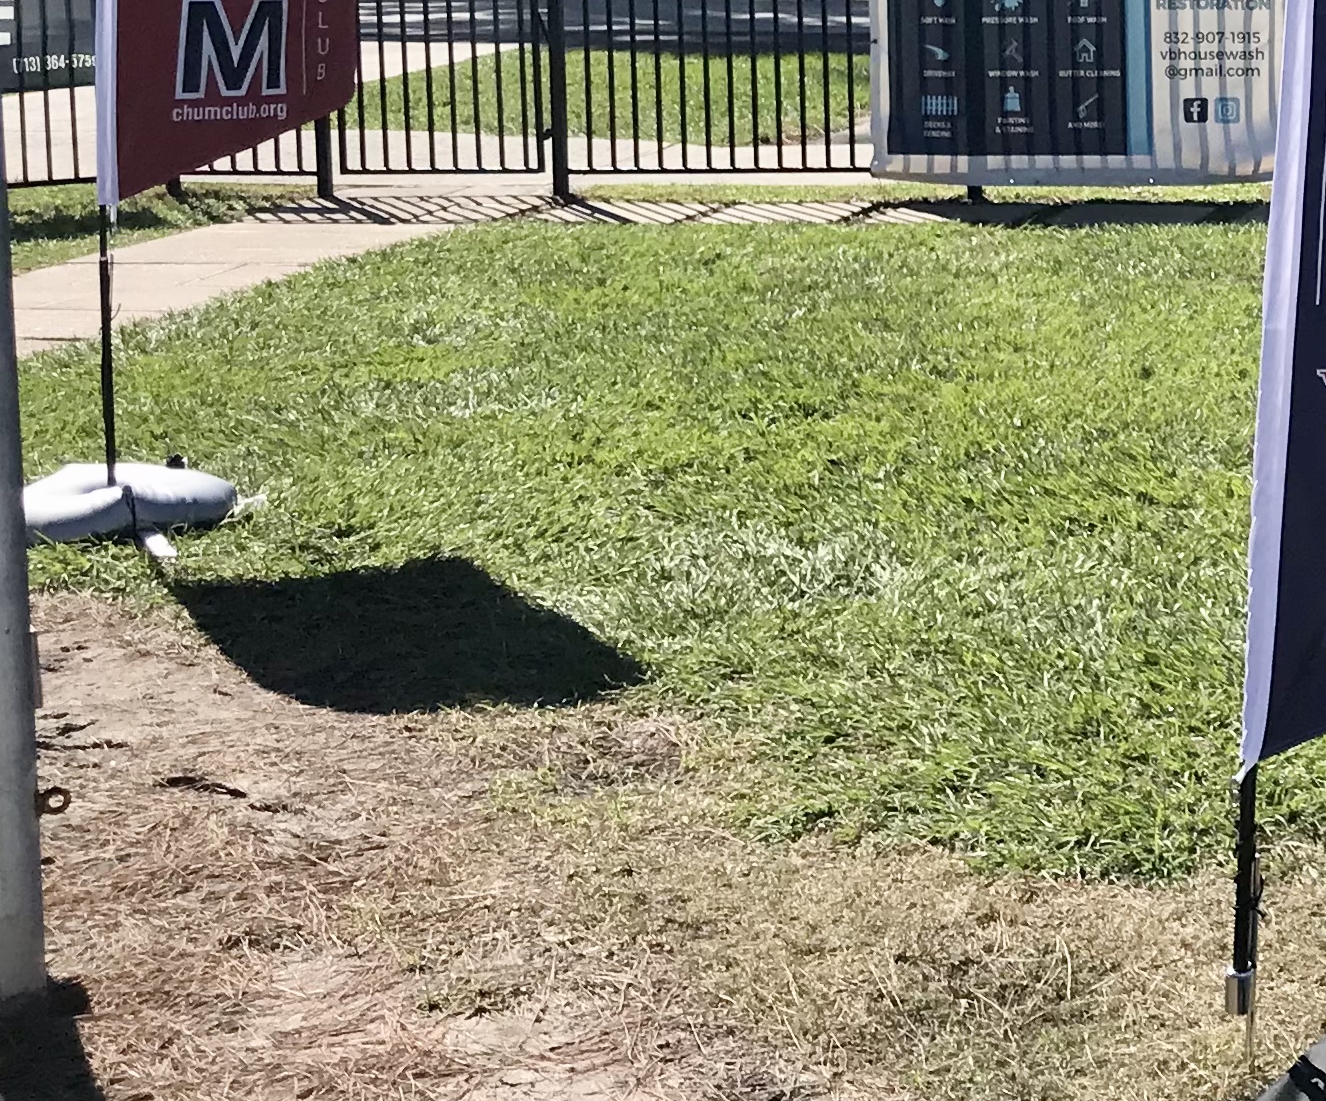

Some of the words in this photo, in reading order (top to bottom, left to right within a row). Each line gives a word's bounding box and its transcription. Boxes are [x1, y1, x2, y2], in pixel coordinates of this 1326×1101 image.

[1163, 31, 1261, 45] 832-907-1915
[1159, 47, 1265, 61] vbhousewash
[12, 56, 40, 74] (13)
[1164, 63, 1261, 80] @gmail.com
[172, 101, 288, 125] chumclub.org
